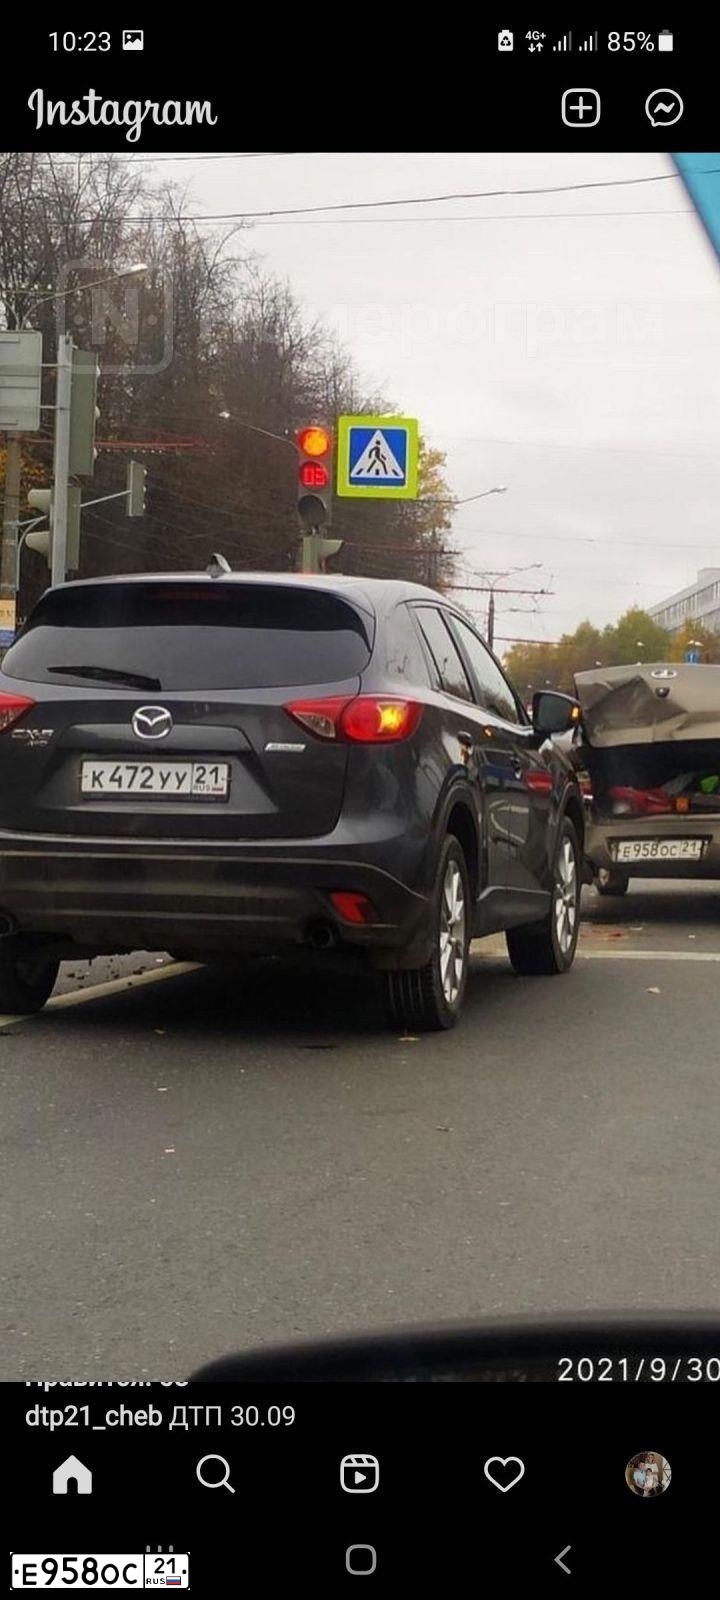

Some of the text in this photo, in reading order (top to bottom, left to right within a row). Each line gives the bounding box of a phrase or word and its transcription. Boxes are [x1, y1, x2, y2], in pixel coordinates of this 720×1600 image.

[49, 32, 111, 52] 10:23
[525, 31, 547, 41] 4G+
[608, 32, 655, 52] 85%
[27, 88, 218, 142] Instagram
[195, 766, 219, 785] 21
[682, 841, 698, 853] 21
[25, 1404, 296, 1432] dtp21_cheb ДТП 30.09
